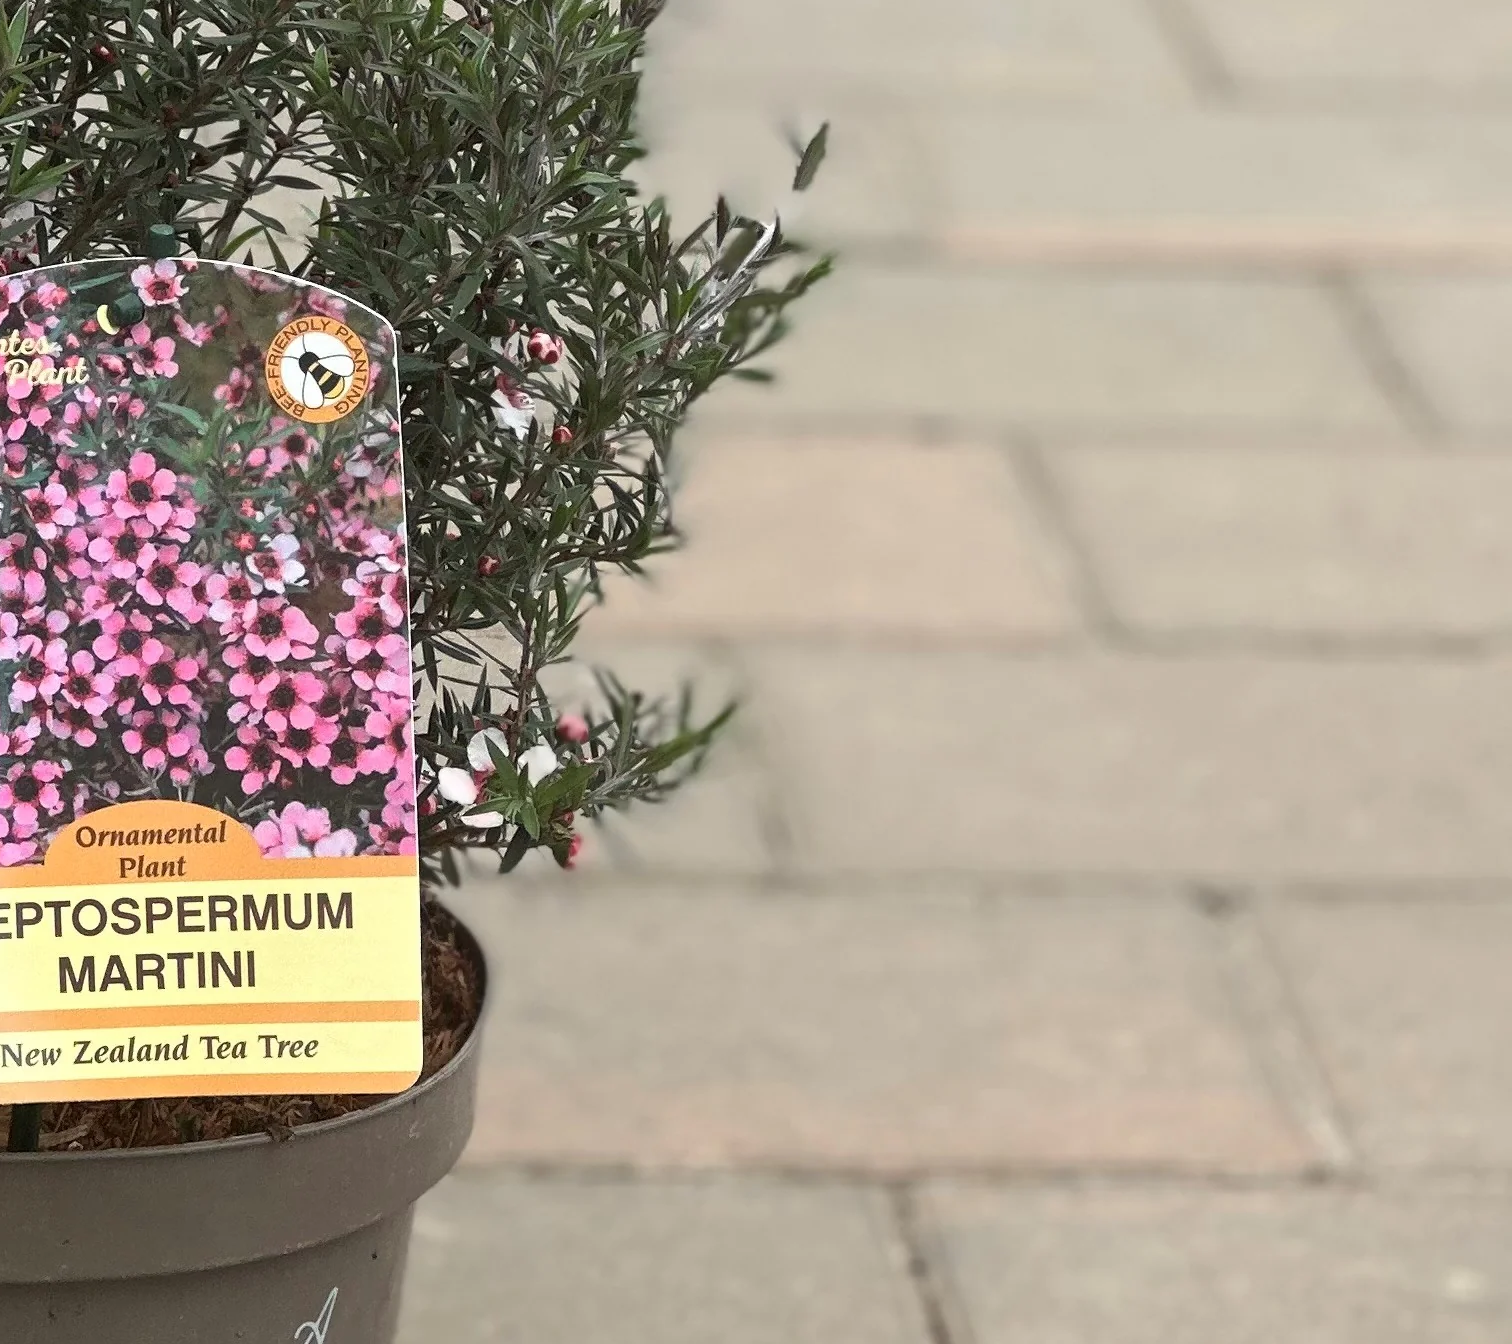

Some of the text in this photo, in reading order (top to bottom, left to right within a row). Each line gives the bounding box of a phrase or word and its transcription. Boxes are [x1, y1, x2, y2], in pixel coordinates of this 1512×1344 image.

[4, 357, 89, 386] Plant
[267, 318, 368, 418] BEE-FRIENDLY PLANTING
[74, 820, 227, 849] Ornamental
[118, 855, 188, 879] Plant
[57, 950, 257, 994] MARTINI
[0, 1034, 320, 1068] New Zealand Tea Tree
